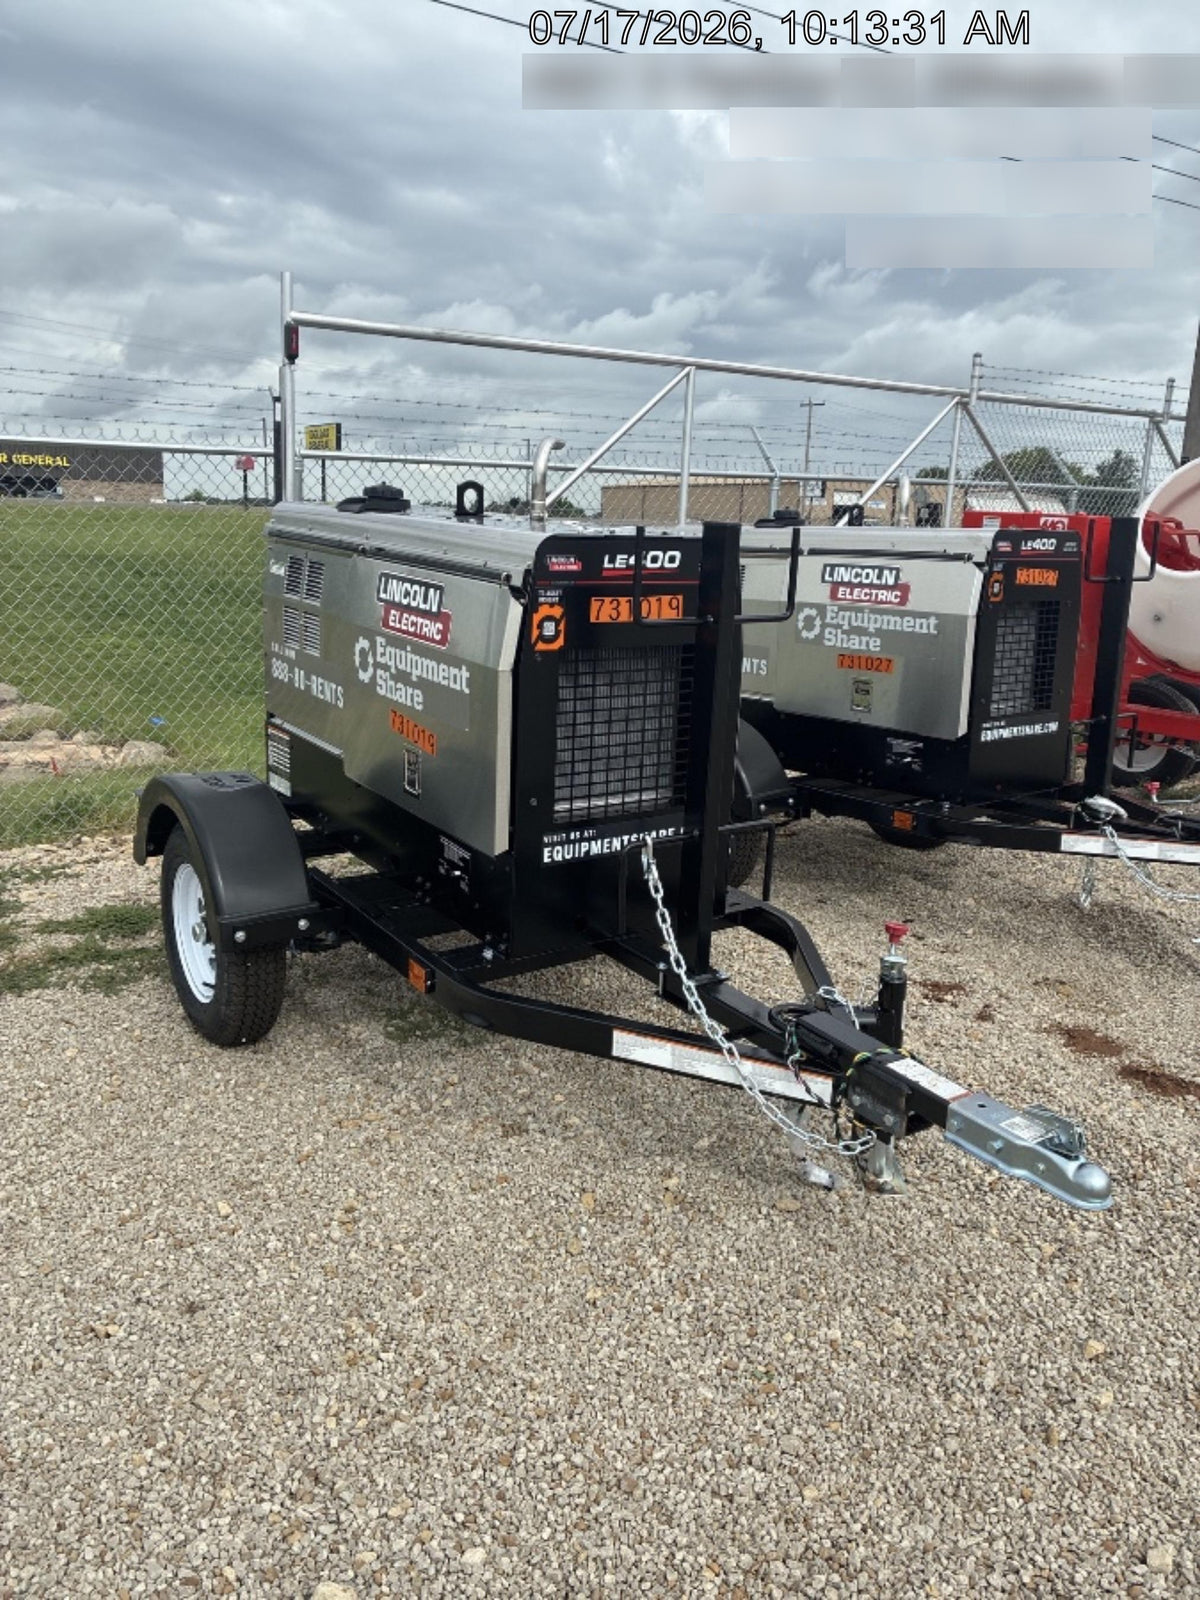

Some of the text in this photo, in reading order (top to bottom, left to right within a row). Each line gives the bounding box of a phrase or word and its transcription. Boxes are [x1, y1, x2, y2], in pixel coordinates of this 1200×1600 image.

[12, 453, 70, 467] GENERAL
[1021, 538, 1057, 551] LE400
[824, 566, 897, 586] LINCOLN
[379, 576, 441, 613] LINCOLN
[837, 586, 902, 604] ELECTRIC
[592, 595, 682, 622] 731019
[824, 605, 940, 635] Equipment
[388, 609, 444, 641] ELECTRIC
[823, 628, 882, 652] Share
[375, 636, 471, 694] Equipment
[838, 653, 893, 673] 731027
[375, 668, 424, 711] Share
[390, 708, 438, 756] 731019
